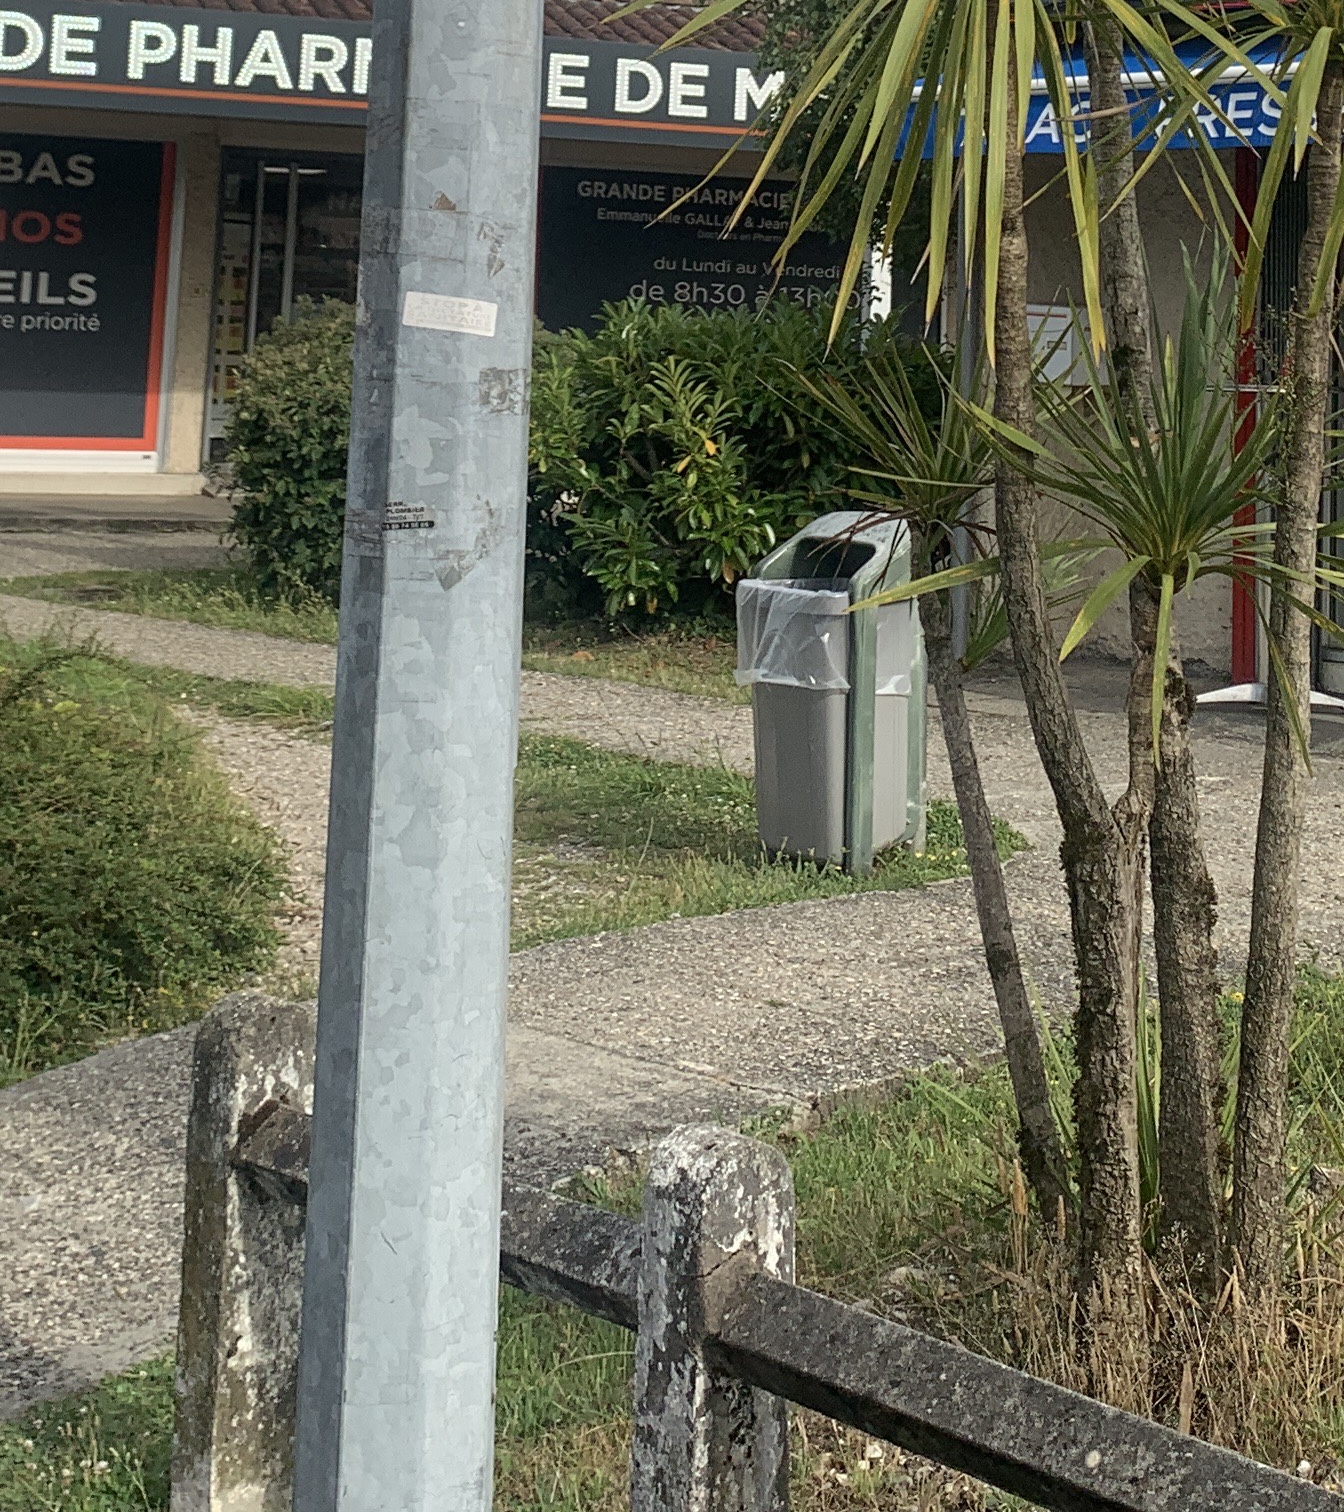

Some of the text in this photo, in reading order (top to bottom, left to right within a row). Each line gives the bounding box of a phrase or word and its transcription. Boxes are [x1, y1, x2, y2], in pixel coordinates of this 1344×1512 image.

[613, 58, 710, 119] DE
[577, 180, 667, 203] GRANDE
[744, 216, 754, 228] &
[653, 256, 841, 279] du Lundi au Vndredi
[629, 279, 665, 303] de
[674, 280, 746, 306] 8h30
[20, 312, 101, 333] priorité
